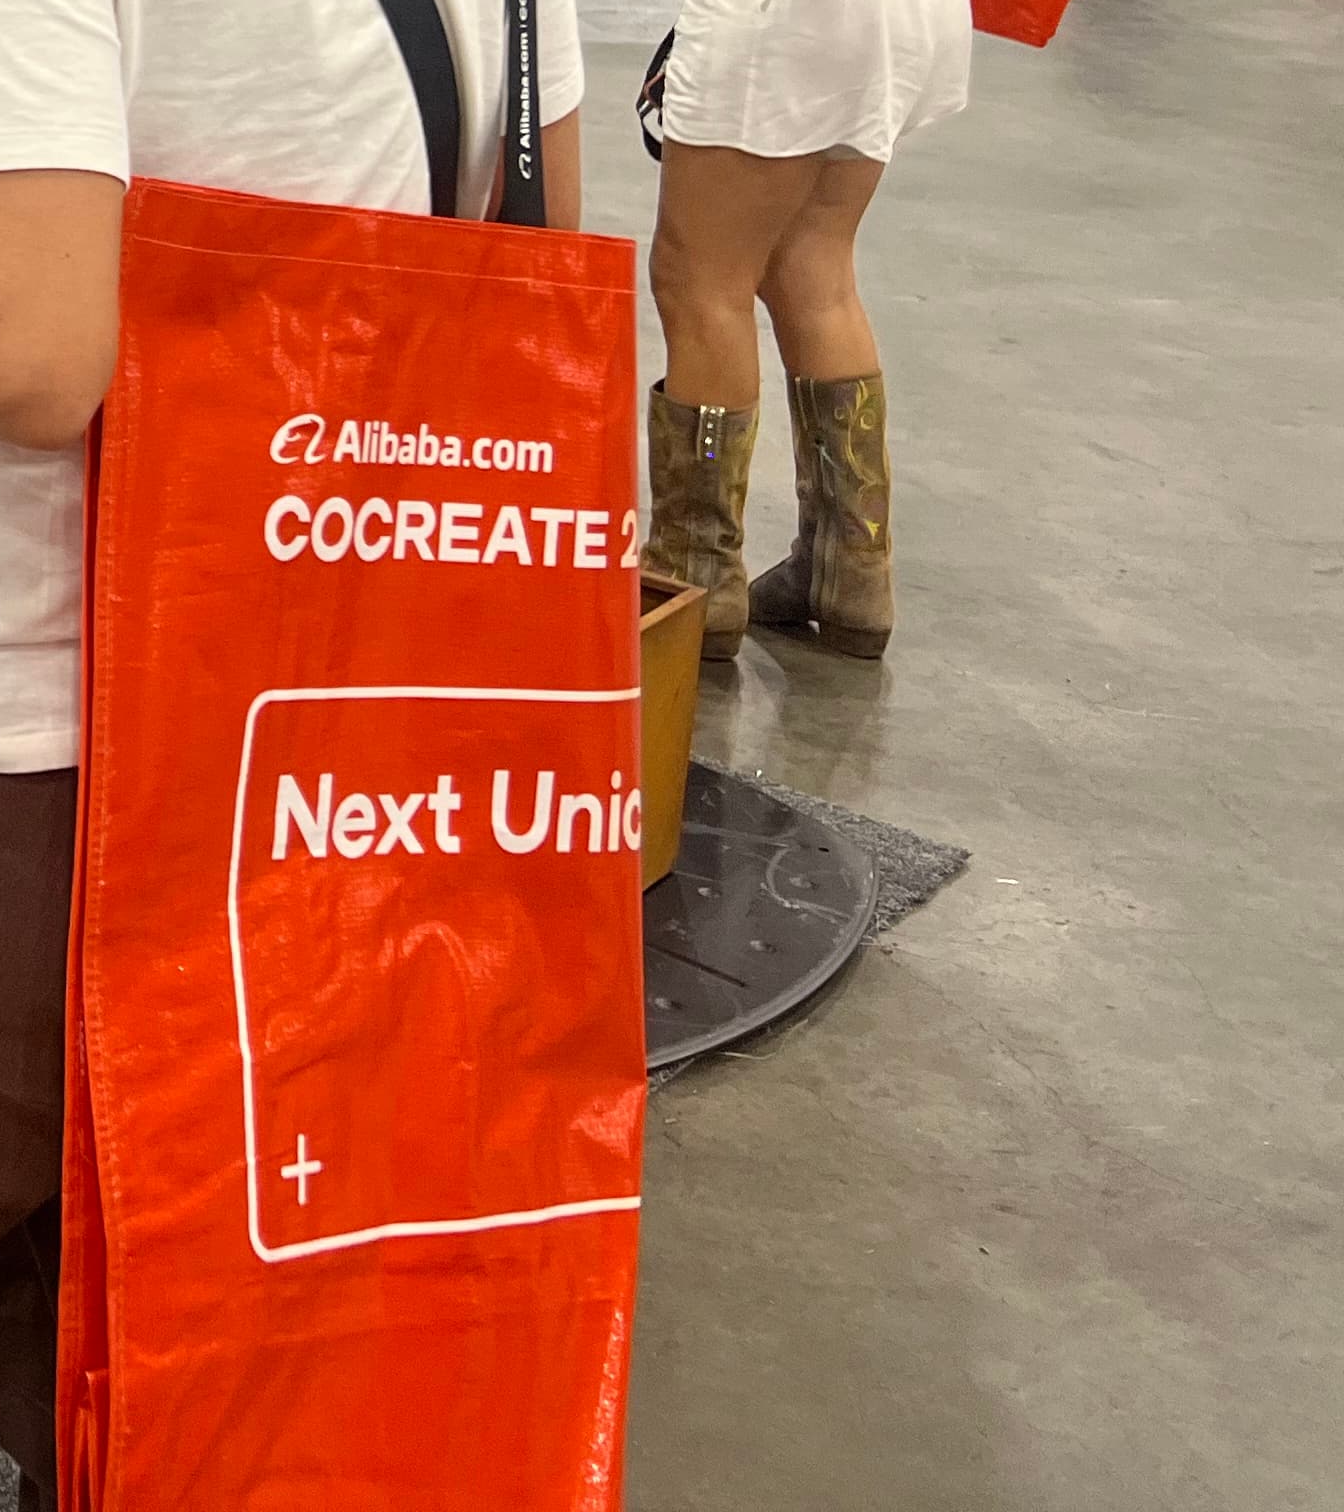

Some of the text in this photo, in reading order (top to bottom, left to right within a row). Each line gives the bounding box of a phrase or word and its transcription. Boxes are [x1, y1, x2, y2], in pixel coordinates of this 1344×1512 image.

[519, 32, 532, 150] Alibaba.com
[334, 420, 553, 475] Alibaba.com
[263, 496, 610, 569] COCREATE
[271, 769, 462, 861] Next
